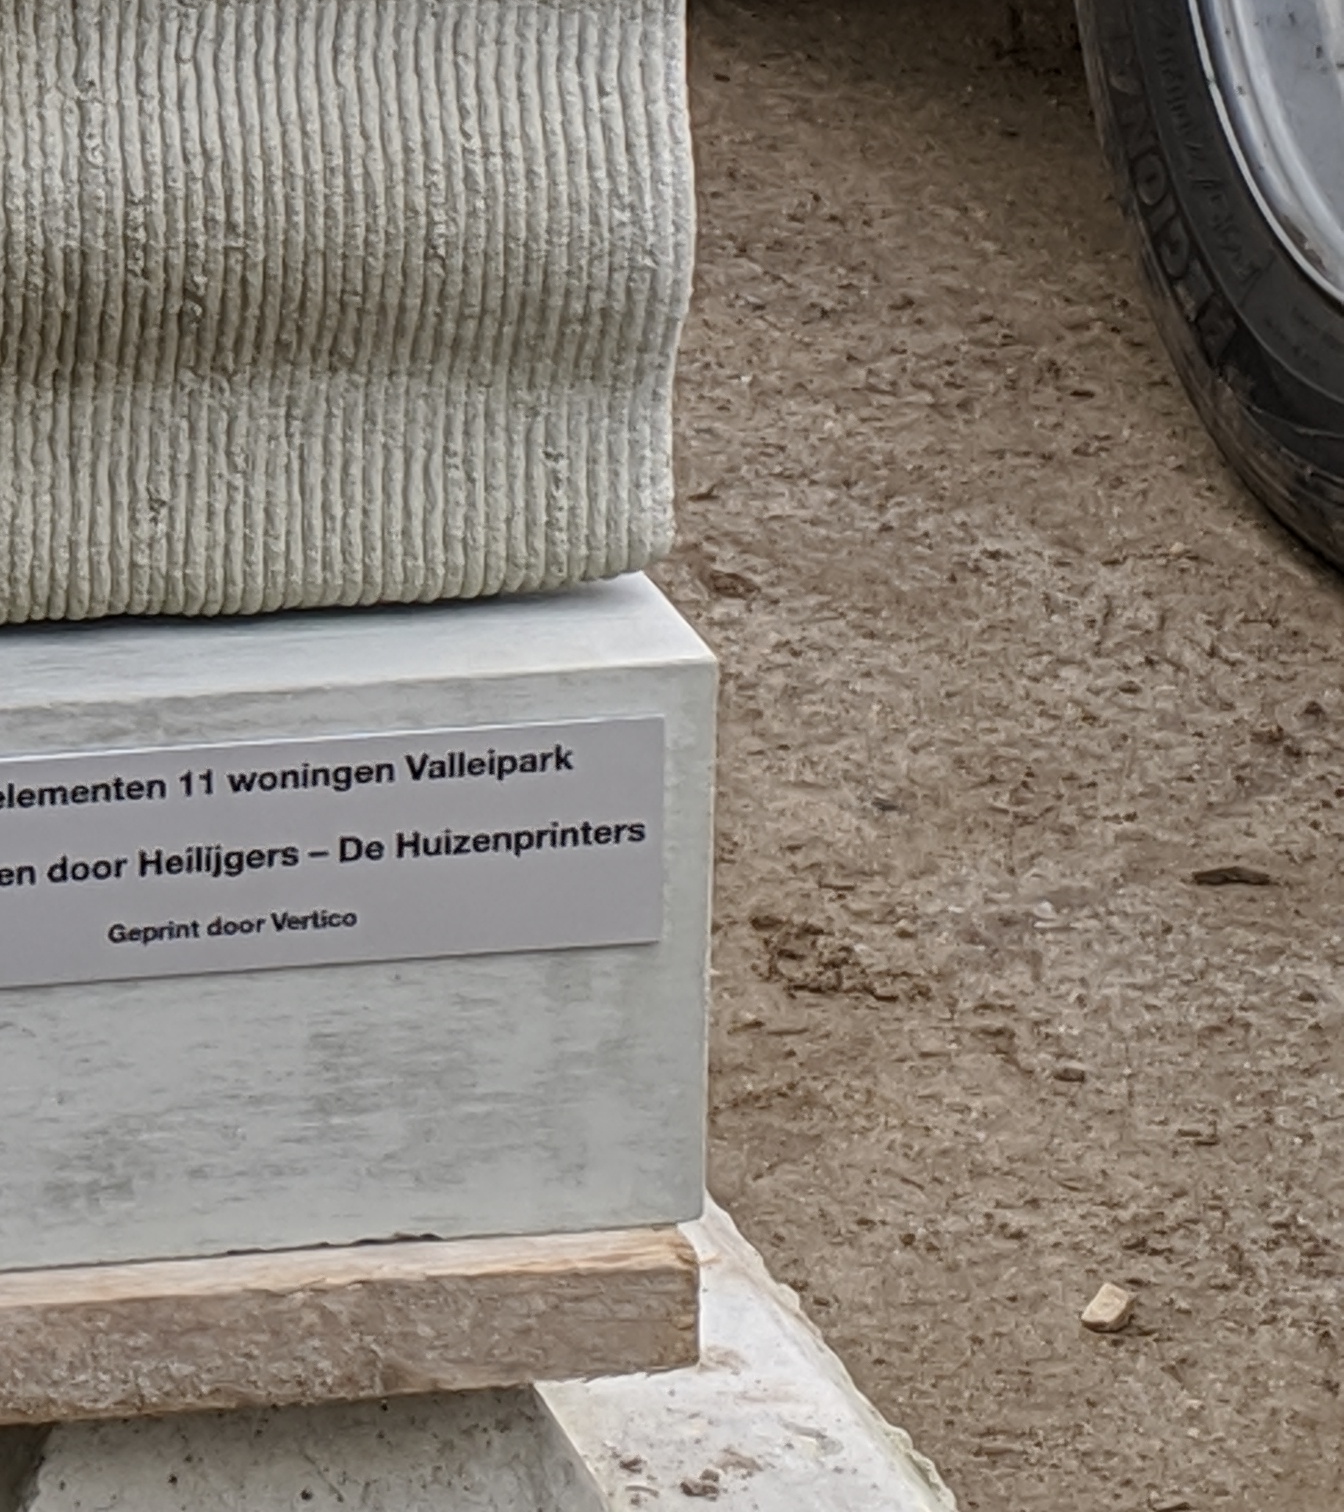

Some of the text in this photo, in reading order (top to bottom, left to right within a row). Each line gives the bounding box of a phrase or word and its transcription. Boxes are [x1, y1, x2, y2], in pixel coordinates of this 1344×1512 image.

[179, 767, 213, 797] 11
[227, 762, 395, 792] woningen
[405, 743, 574, 781] Valleipark
[47, 854, 127, 882] door
[138, 843, 299, 878] Heilijgers
[338, 835, 385, 863] De
[395, 821, 645, 858] Huizenprinters
[108, 909, 358, 945] Geprint door Vertico
